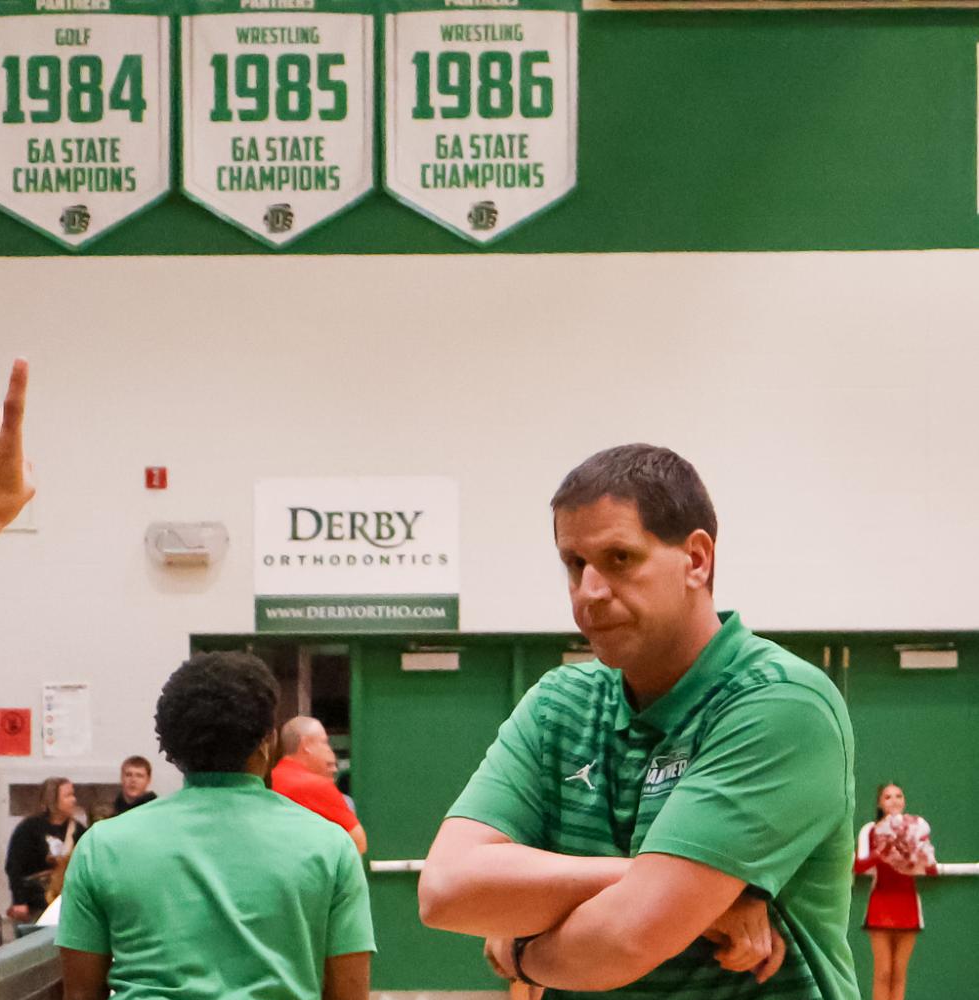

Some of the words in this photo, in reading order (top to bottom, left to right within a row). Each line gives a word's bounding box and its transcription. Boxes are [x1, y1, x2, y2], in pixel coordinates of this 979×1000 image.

[55, 28, 91, 46] GOLF
[236, 26, 320, 45] WRESTLING
[440, 23, 524, 42] WRESTLING
[2, 54, 147, 124] 1984
[209, 53, 348, 122] 1985
[411, 50, 554, 120] 1986
[27, 138, 56, 164] 6A
[61, 137, 121, 164] STATE
[231, 136, 260, 162] 6A
[265, 136, 325, 163] STATE
[435, 134, 464, 160] 6A
[469, 133, 529, 160] STATE
[12, 166, 136, 193] CHAMPIONS
[216, 165, 341, 191] CHAMPIONS
[421, 162, 545, 189] CHAMPIONS
[288, 507, 423, 549] DERBY
[263, 553, 448, 567] ORTHODONTICS
